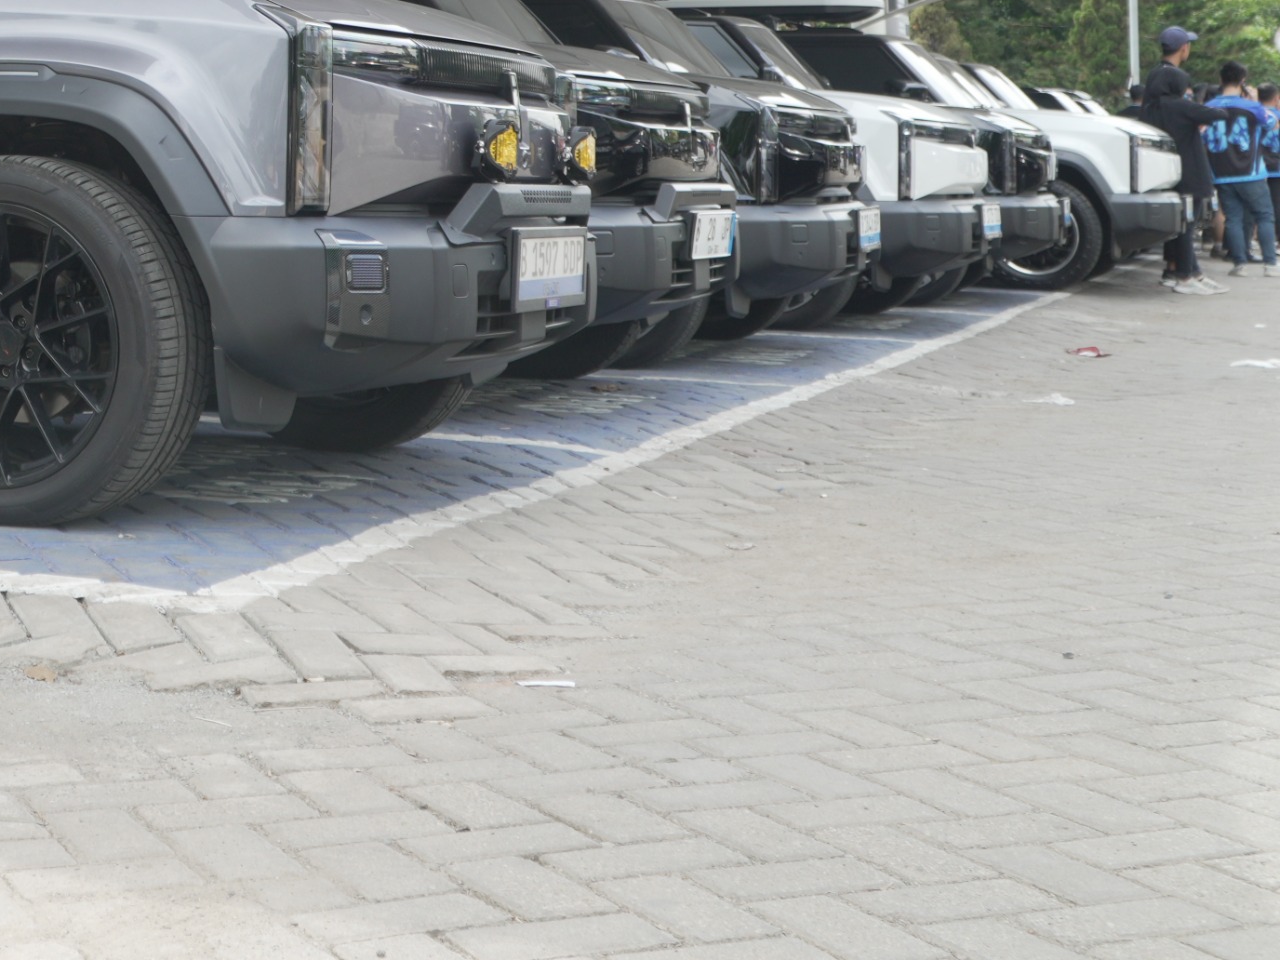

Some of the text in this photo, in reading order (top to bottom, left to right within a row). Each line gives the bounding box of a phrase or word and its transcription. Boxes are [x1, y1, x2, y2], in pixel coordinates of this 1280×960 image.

[520, 239, 583, 278] B 1597 BDP
